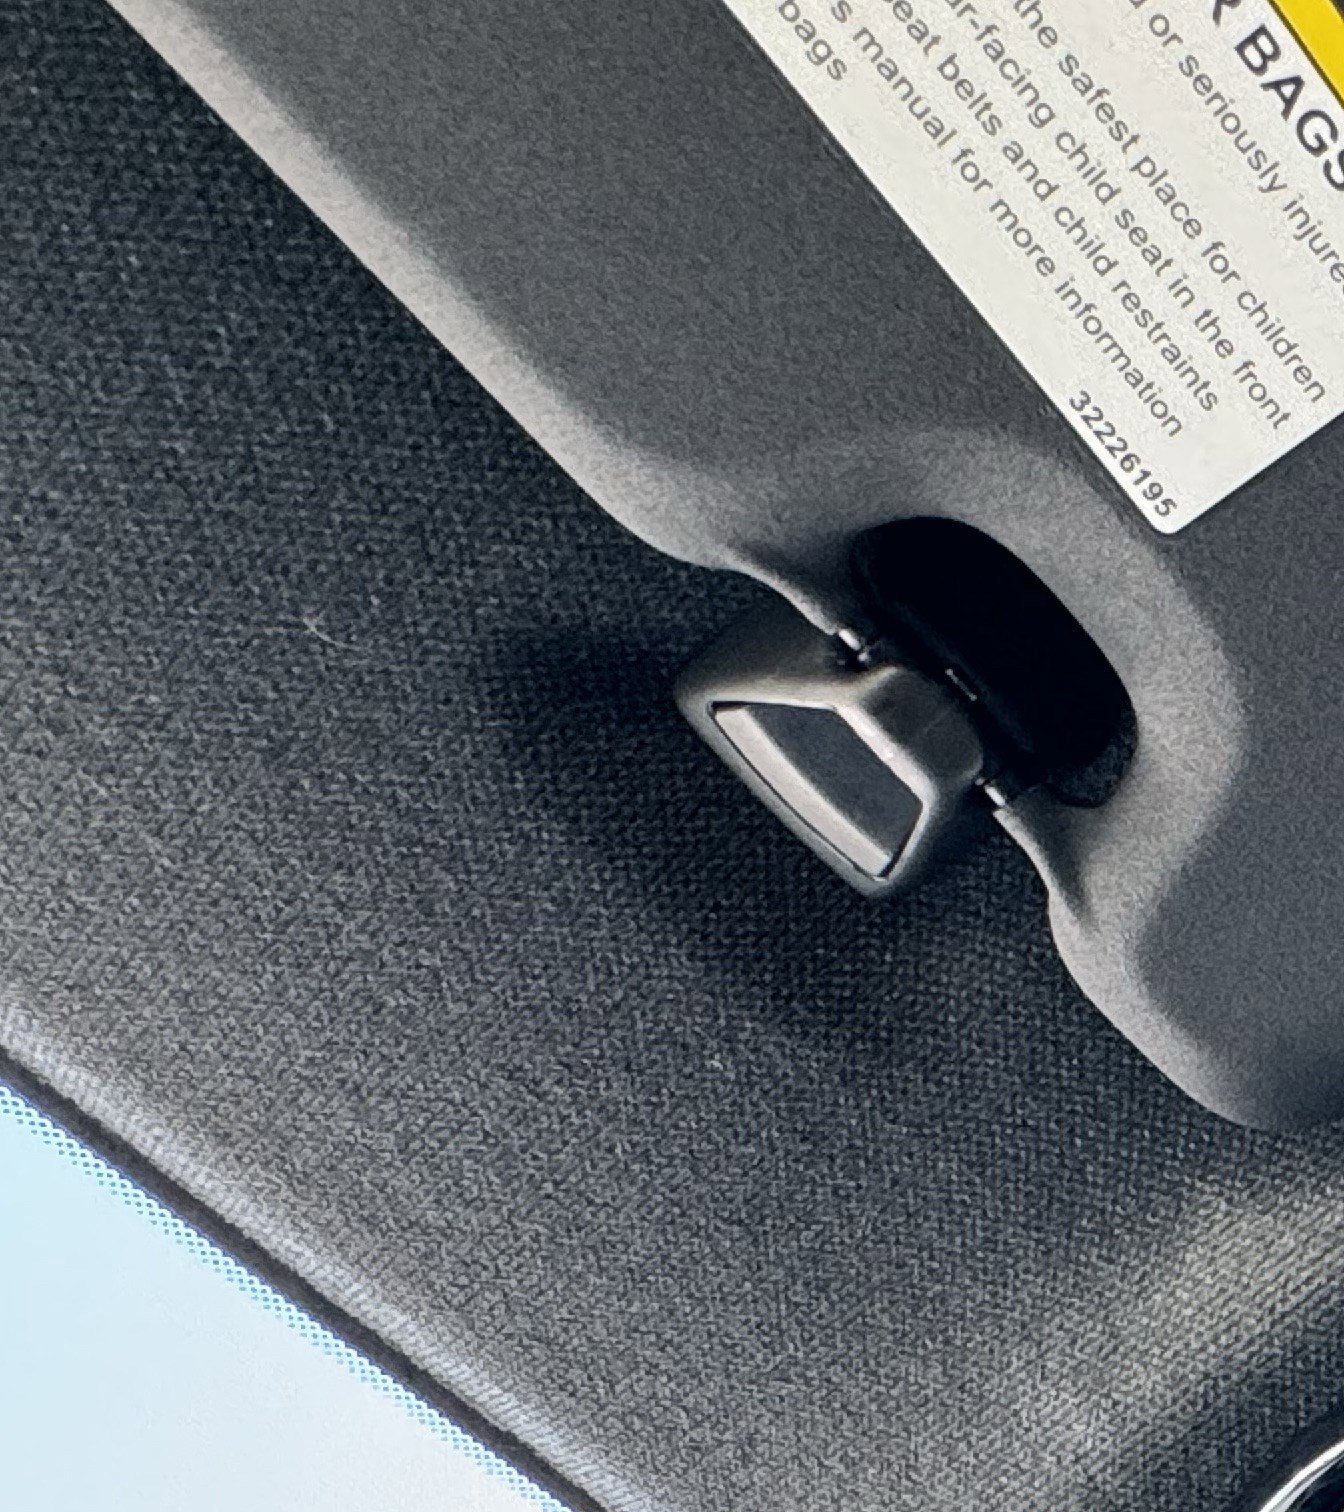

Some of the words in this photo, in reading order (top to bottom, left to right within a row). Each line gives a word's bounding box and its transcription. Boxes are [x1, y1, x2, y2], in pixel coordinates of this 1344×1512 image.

[778, 0, 848, 82] bags
[886, 0, 942, 56] eat
[936, 52, 1003, 137] belts
[1002, 141, 1061, 202] and
[1054, 206, 1119, 277] child
[1111, 280, 1219, 412] restraints
[947, 0, 1056, 129] r-facing
[1055, 131, 1122, 205] child
[1114, 208, 1174, 277] seat
[1168, 273, 1195, 309] in
[1194, 309, 1234, 359] the
[1233, 360, 1291, 429] front
[1149, 14, 1183, 47] or
[1179, 54, 1288, 194] seriously
[853, 27, 957, 149] manual
[951, 148, 993, 192] for
[988, 199, 1056, 278] more
[1054, 276, 1183, 438] information
[1058, 53, 1141, 154] safest
[1129, 155, 1202, 240] place
[1201, 241, 1241, 283] for
[1237, 291, 1326, 402] children
[1069, 390, 1178, 518] 32226195
